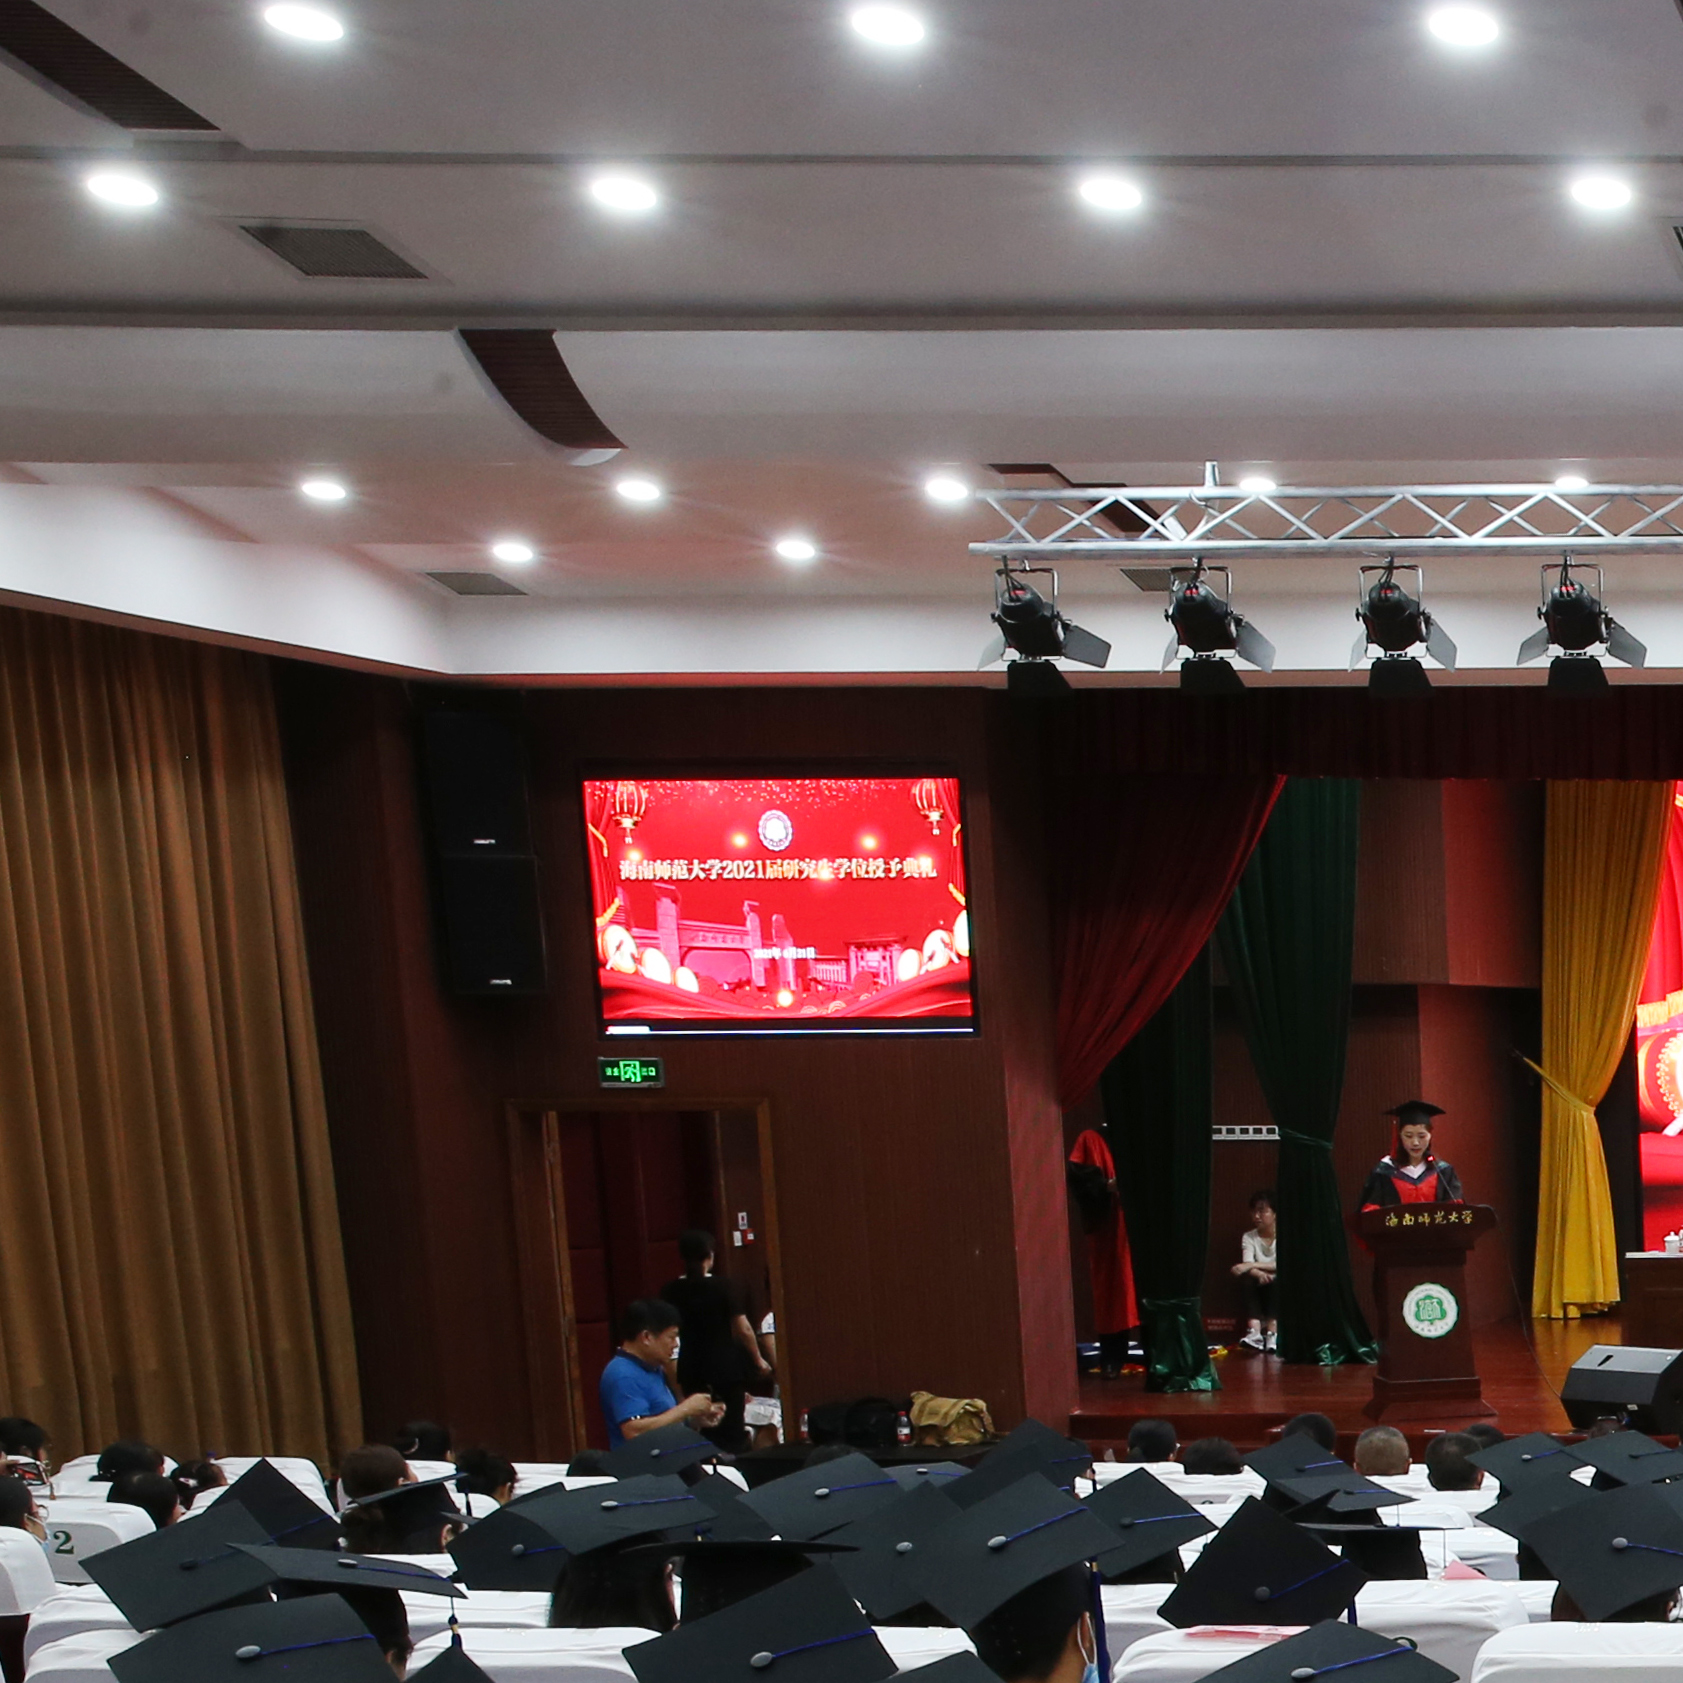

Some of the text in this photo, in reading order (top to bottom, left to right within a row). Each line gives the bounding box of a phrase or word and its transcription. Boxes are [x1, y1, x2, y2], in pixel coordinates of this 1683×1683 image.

[618, 857, 938, 881] 海南师范大学2021届研究生学位授予典礼
